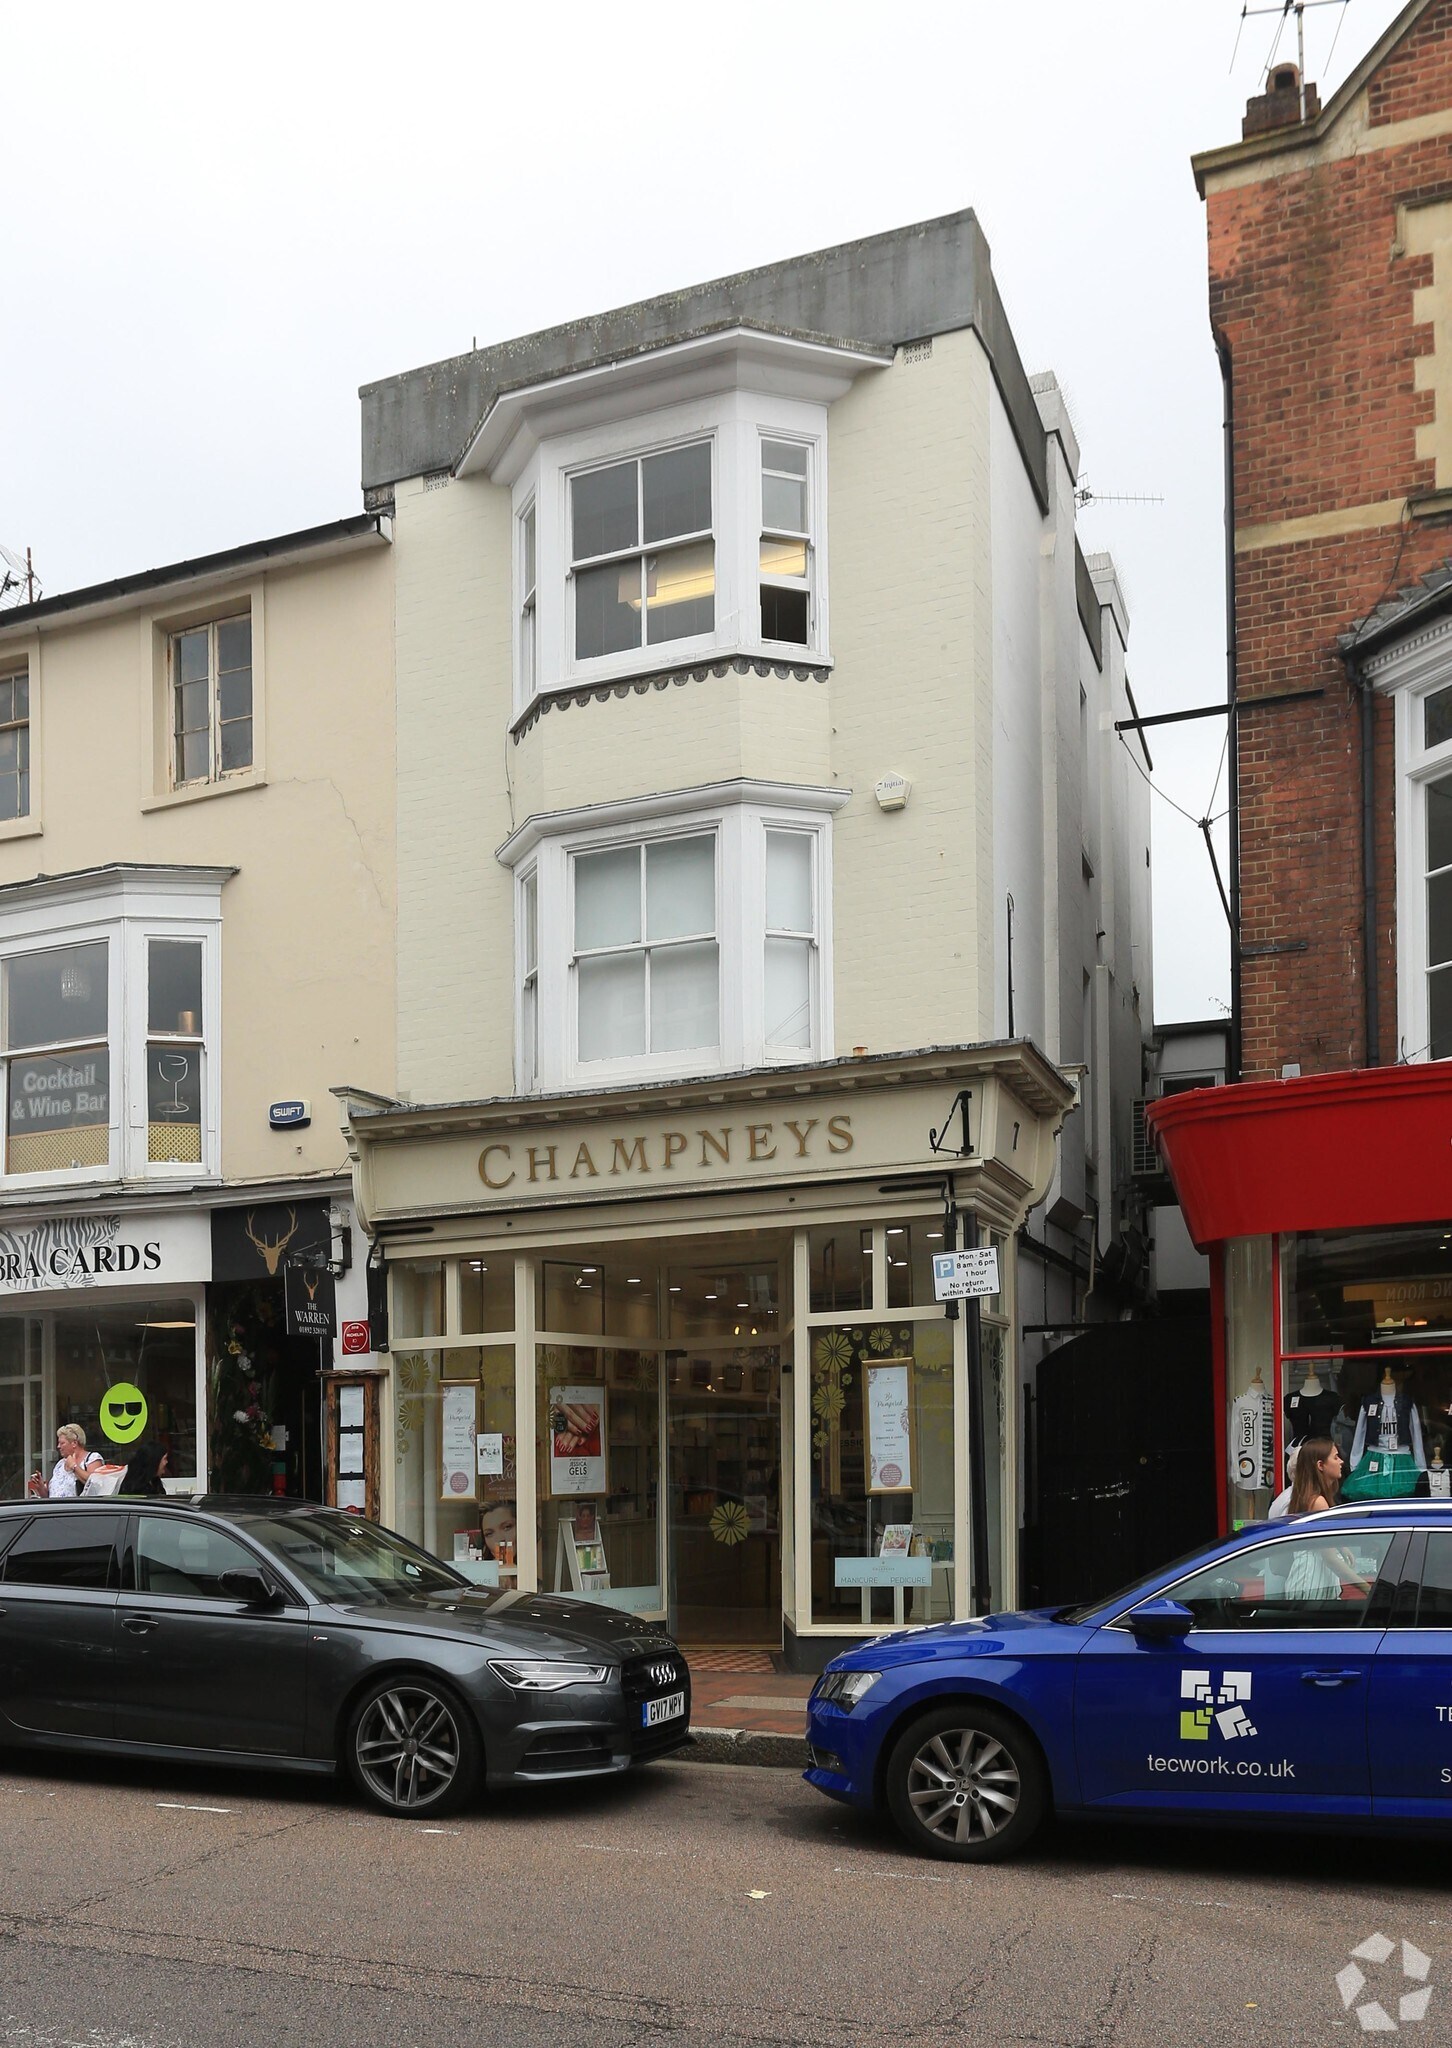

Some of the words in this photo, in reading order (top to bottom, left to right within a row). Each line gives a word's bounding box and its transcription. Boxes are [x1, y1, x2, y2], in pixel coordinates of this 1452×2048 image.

[884, 779, 904, 789] Initial
[23, 1063, 97, 1093] Cocktail
[12, 1099, 26, 1120] &
[28, 1095, 72, 1119] Wine
[75, 1091, 108, 1113] Bar
[273, 1106, 302, 1118] SWIFT
[49, 1241, 162, 1276] CARDS
[984, 1259, 996, 1267] pm
[961, 1280, 985, 1288] return
[942, 1289, 964, 1297] within
[307, 1302, 318, 1311] THE
[295, 1310, 330, 1324] WARREN
[1242, 1412, 1253, 1443] oops!
[568, 1467, 588, 1476] GELS
[1146, 1754, 1296, 1778] tecwork.co.uk
